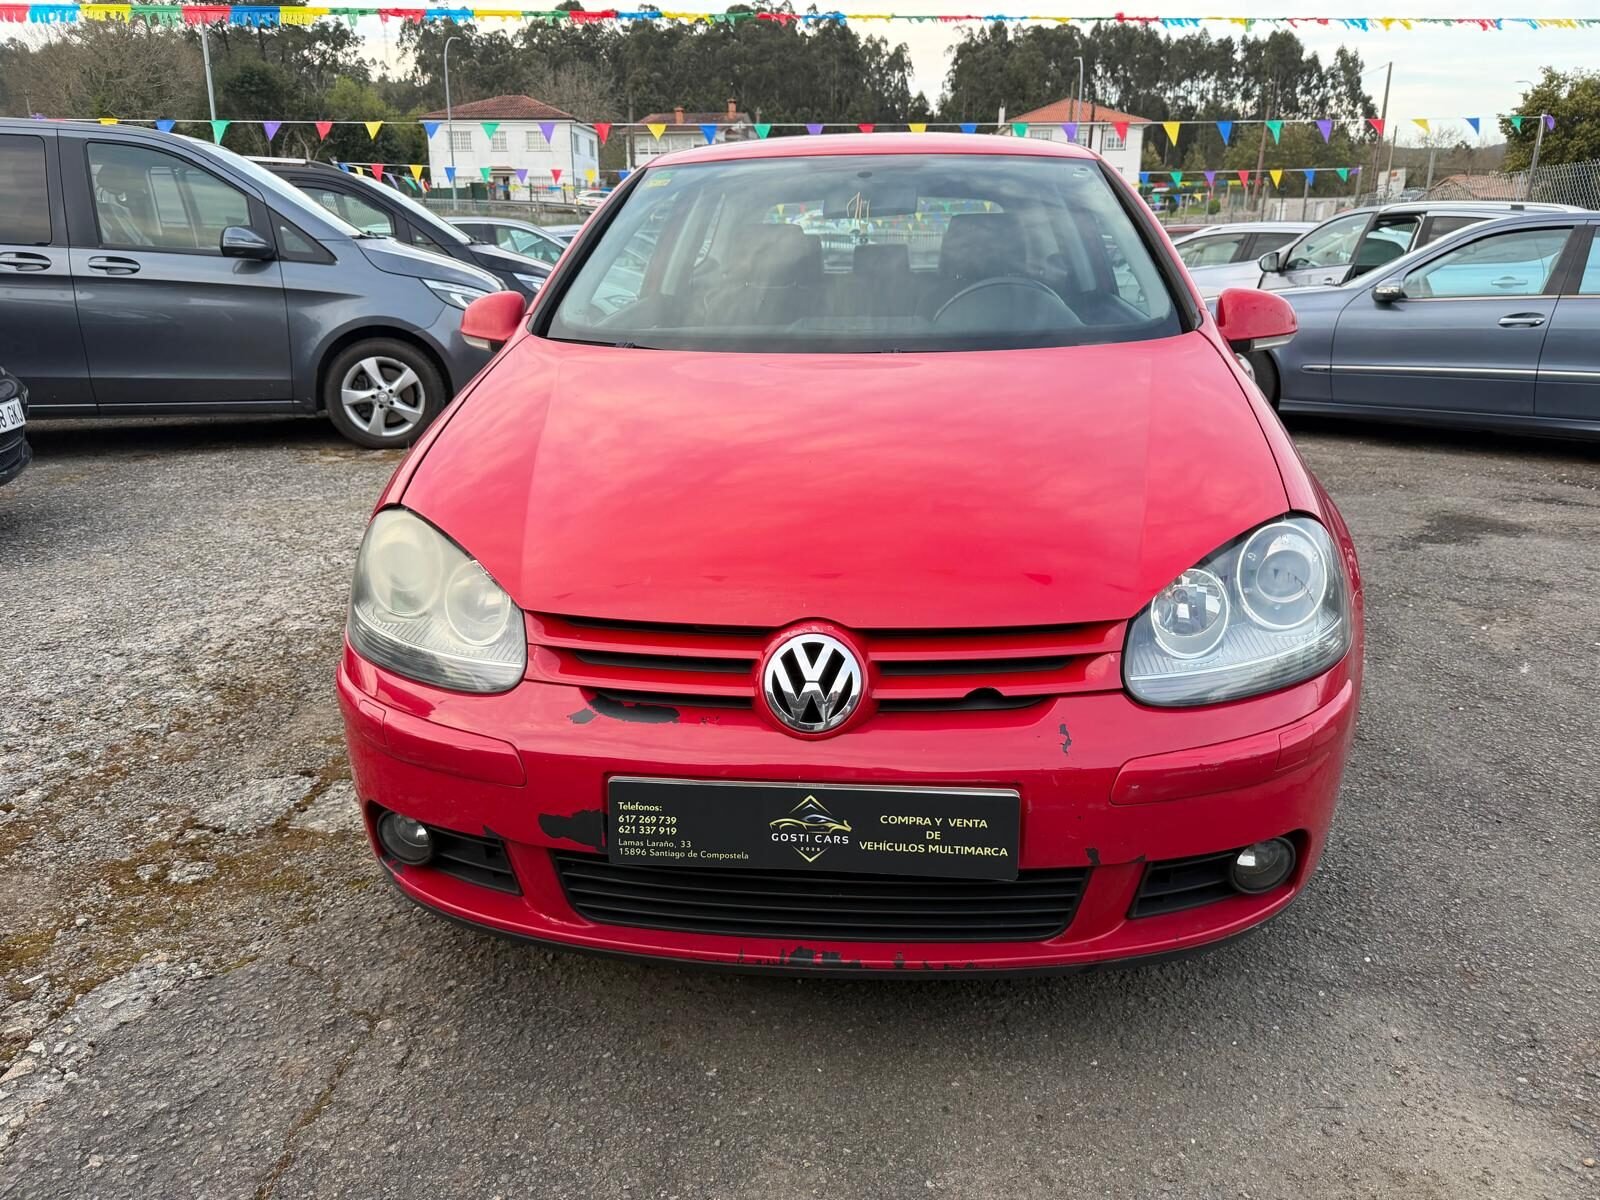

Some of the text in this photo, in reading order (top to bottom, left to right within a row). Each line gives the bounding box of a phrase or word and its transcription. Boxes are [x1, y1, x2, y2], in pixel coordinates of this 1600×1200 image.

[618, 802, 662, 812] Telefonos:
[618, 814, 677, 825] 617 269 739
[880, 815, 988, 828] COMPRA Y VENTA
[618, 826, 677, 836] 621 337 919
[926, 830, 941, 840] DE
[618, 838, 644, 847] Lamas
[646, 840, 676, 848] Laraño,
[771, 833, 849, 844] GOSTI CARS
[859, 840, 1008, 856] VEHÍCULOS MULTIMARCA
[619, 848, 646, 856] 15896
[650, 849, 685, 860] Santiago
[700, 850, 749, 861] Compostela
